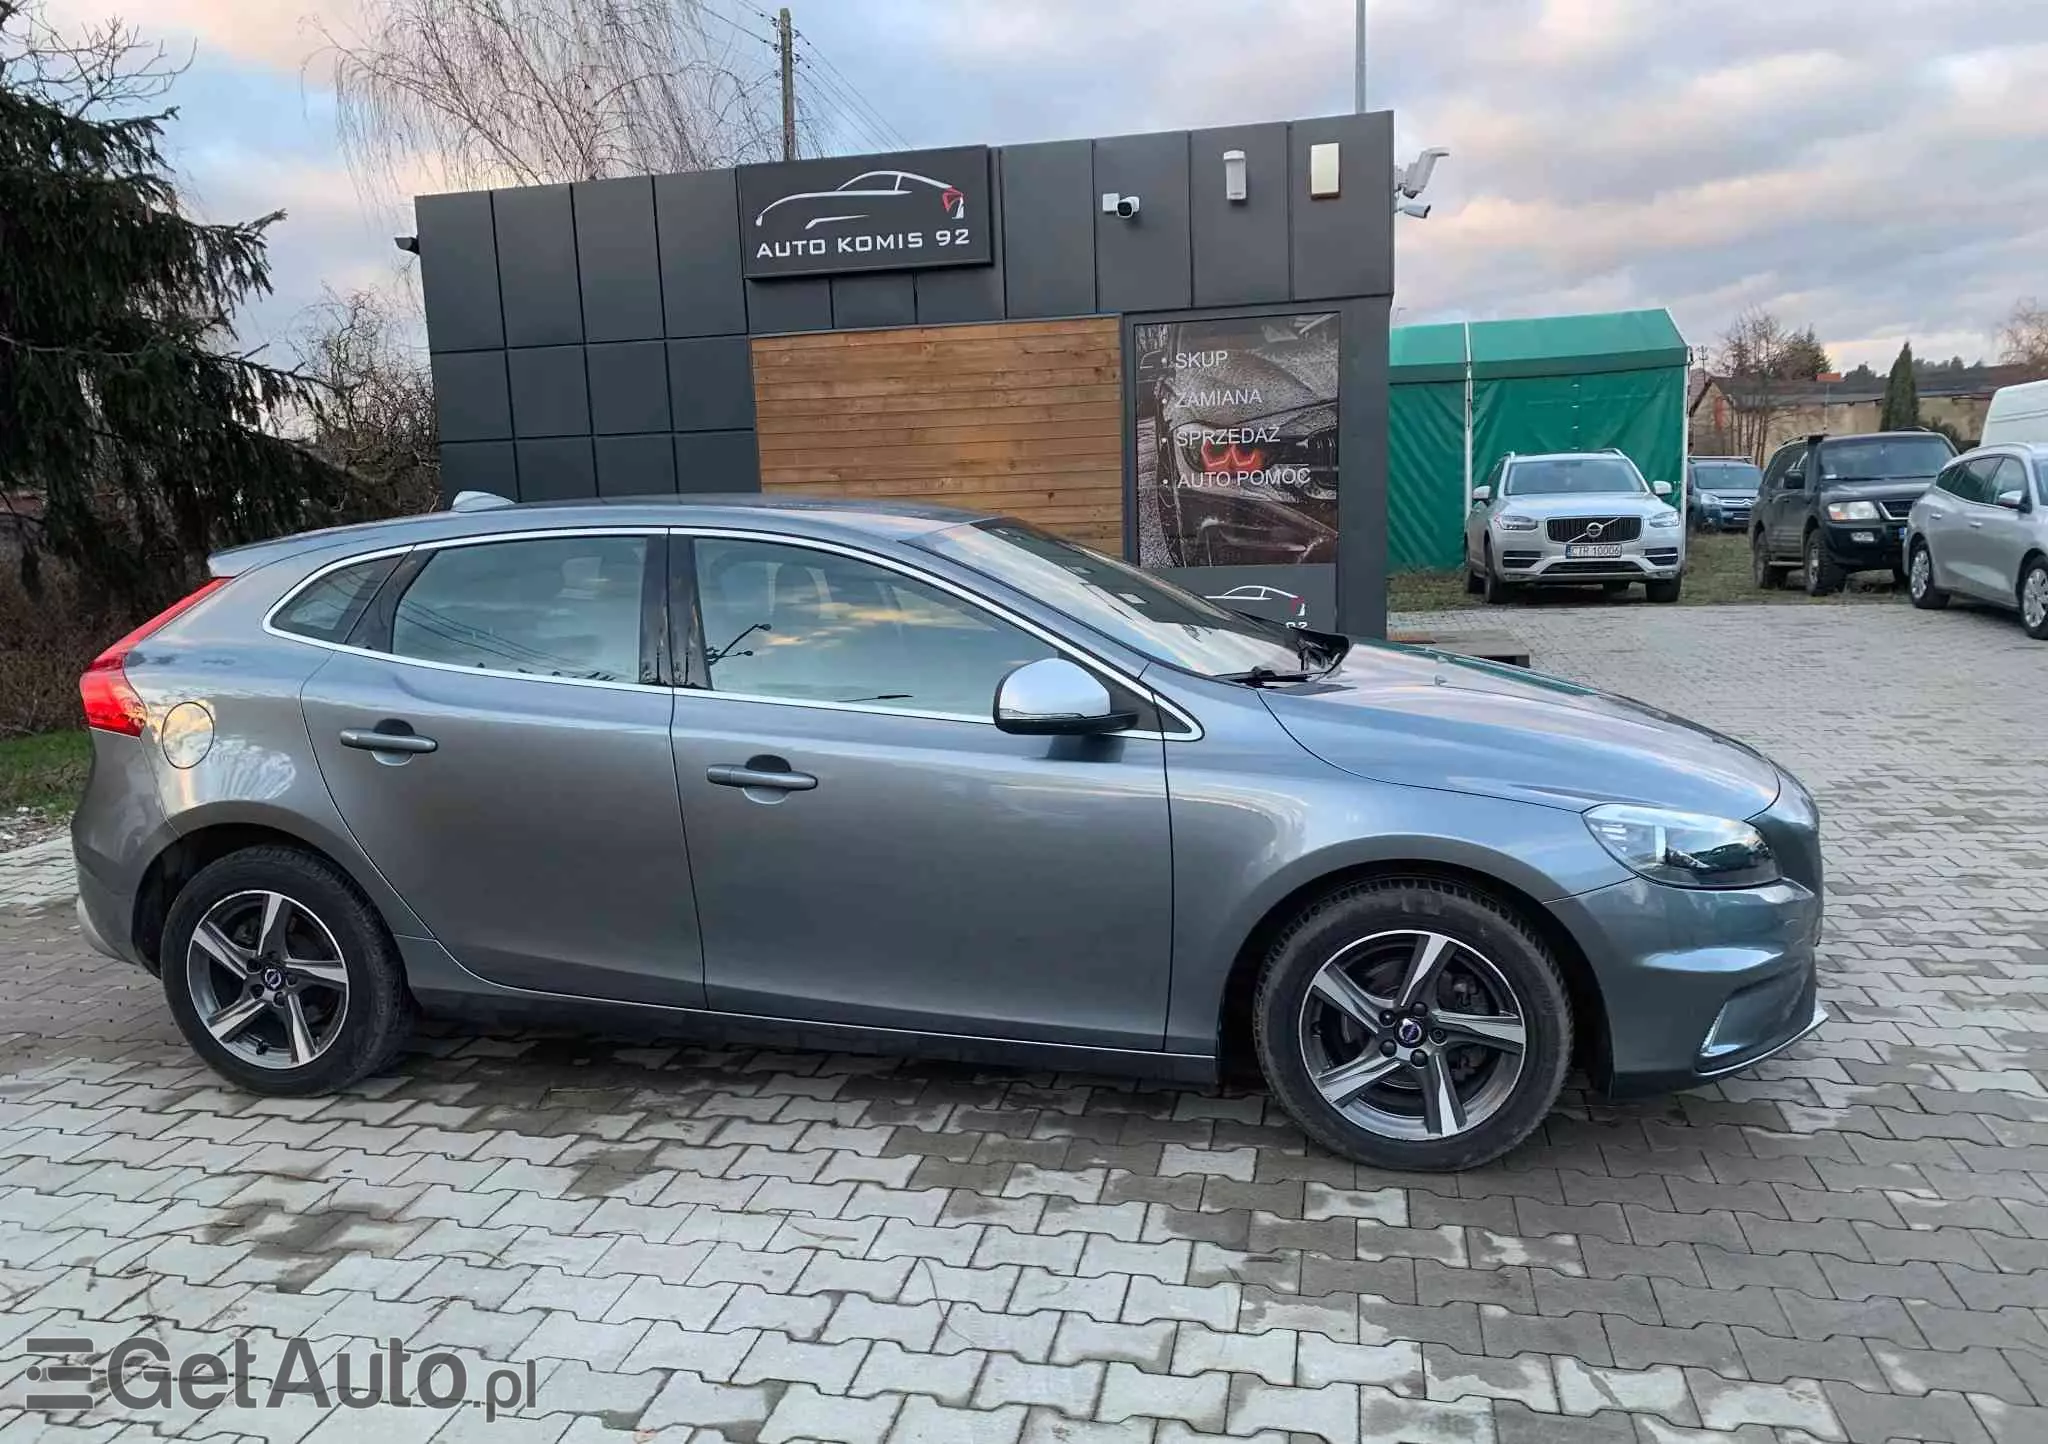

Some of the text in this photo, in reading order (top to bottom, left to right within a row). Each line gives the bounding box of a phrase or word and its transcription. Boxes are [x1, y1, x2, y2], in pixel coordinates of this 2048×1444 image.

[757, 229, 970, 258] AUTO KOMIS 92
[1175, 351, 1228, 368] SKUP
[1175, 389, 1262, 408] ZAMIANA
[1177, 467, 1311, 488] AUTO POMOC
